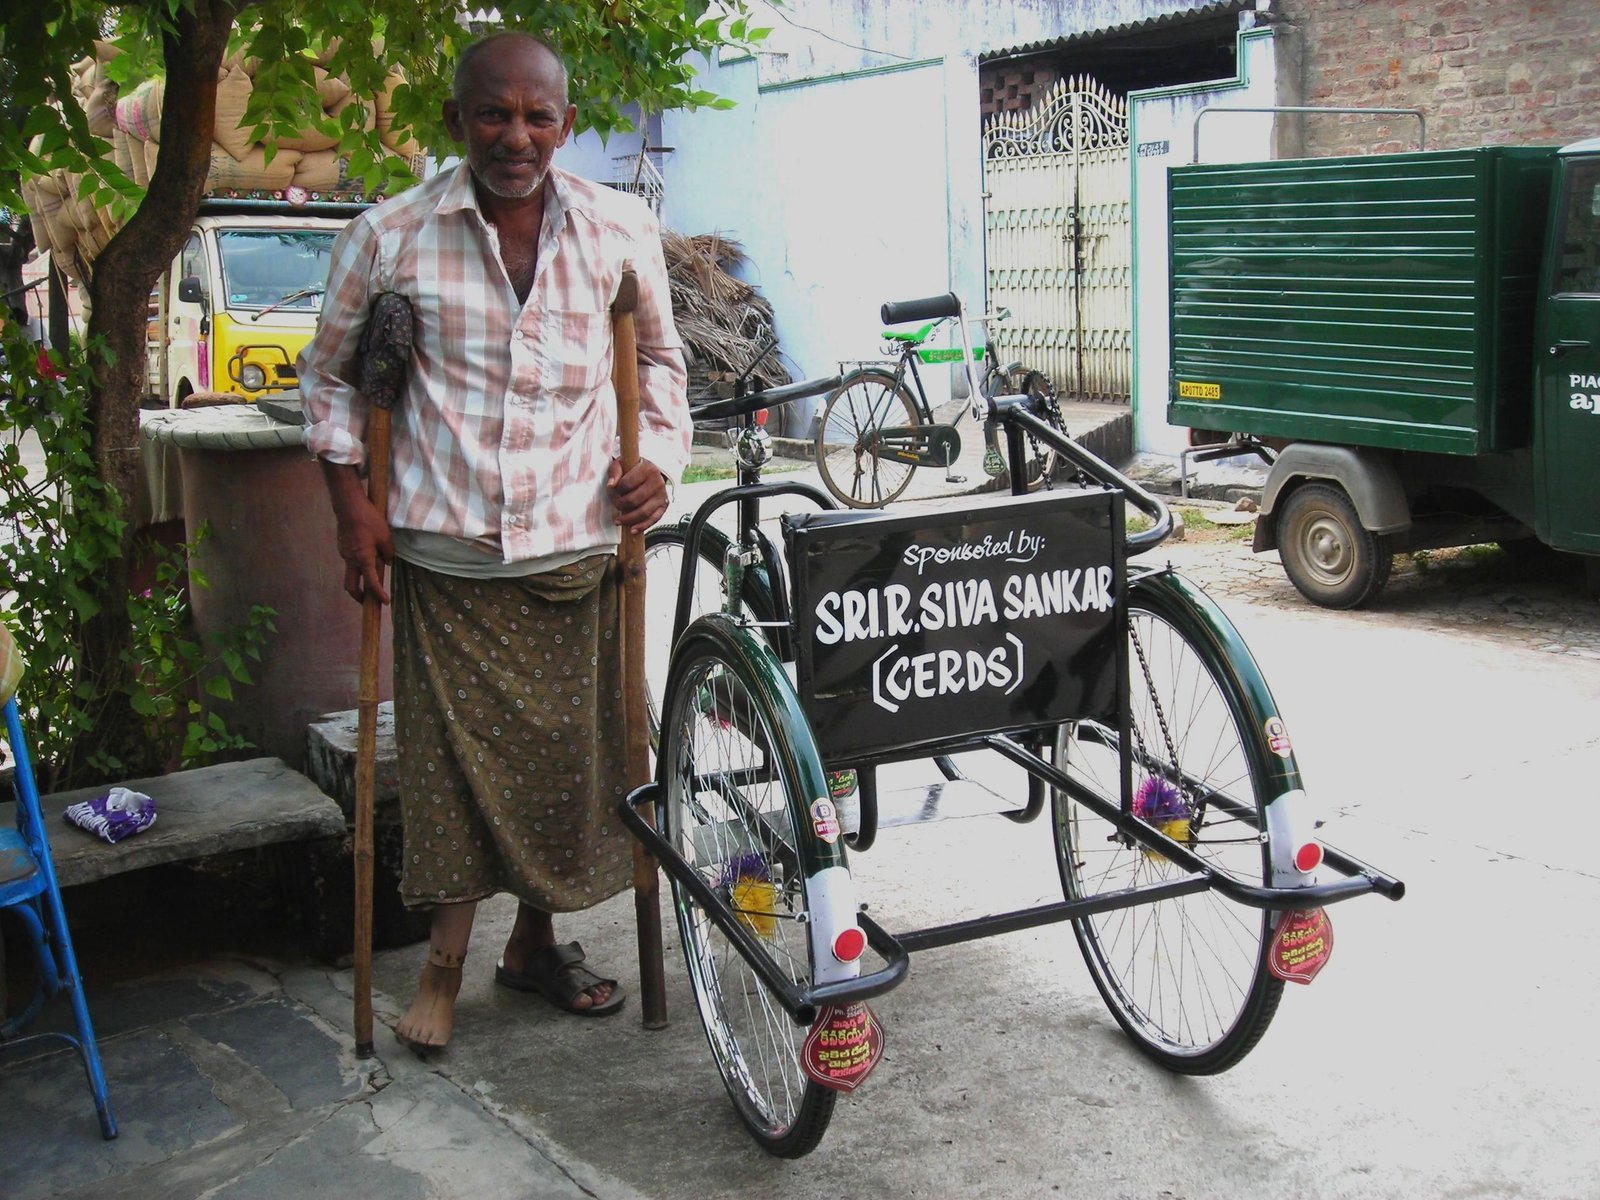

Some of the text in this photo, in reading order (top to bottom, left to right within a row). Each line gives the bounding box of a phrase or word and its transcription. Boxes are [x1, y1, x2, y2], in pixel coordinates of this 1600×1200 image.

[904, 529, 1046, 575] Sponsored by:
[1002, 566, 1116, 621] SANKAR
[873, 633, 1024, 713] (CERDS)
